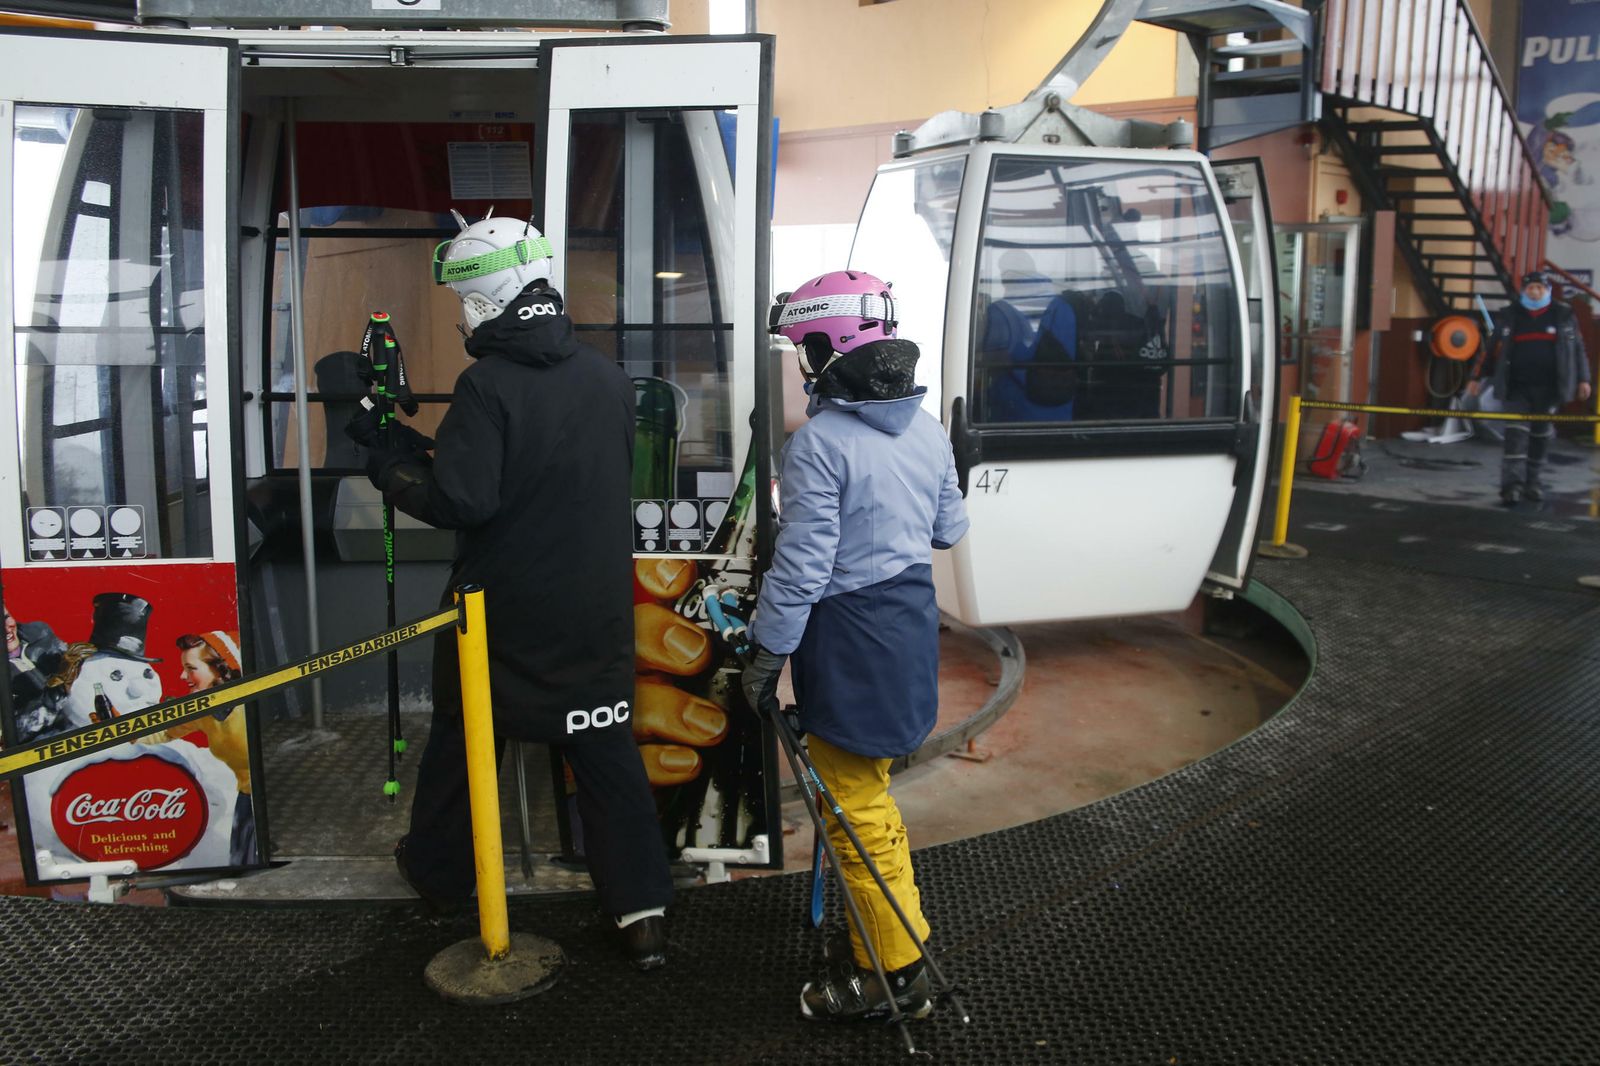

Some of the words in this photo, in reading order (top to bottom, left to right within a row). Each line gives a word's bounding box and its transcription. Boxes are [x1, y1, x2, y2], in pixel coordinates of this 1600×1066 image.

[1522, 36, 1600, 67] PUL
[447, 263, 480, 275] ATOMIC
[787, 302, 829, 317] ATOMIC
[976, 468, 1009, 494] 47
[298, 625, 419, 676] TENSABARRIER
[35, 696, 212, 761] TENSABARRIER
[66, 787, 188, 826] Coca-Cola
[91, 832, 148, 844] Delicious
[153, 829, 177, 840] and
[104, 842, 169, 855] Refreshing
